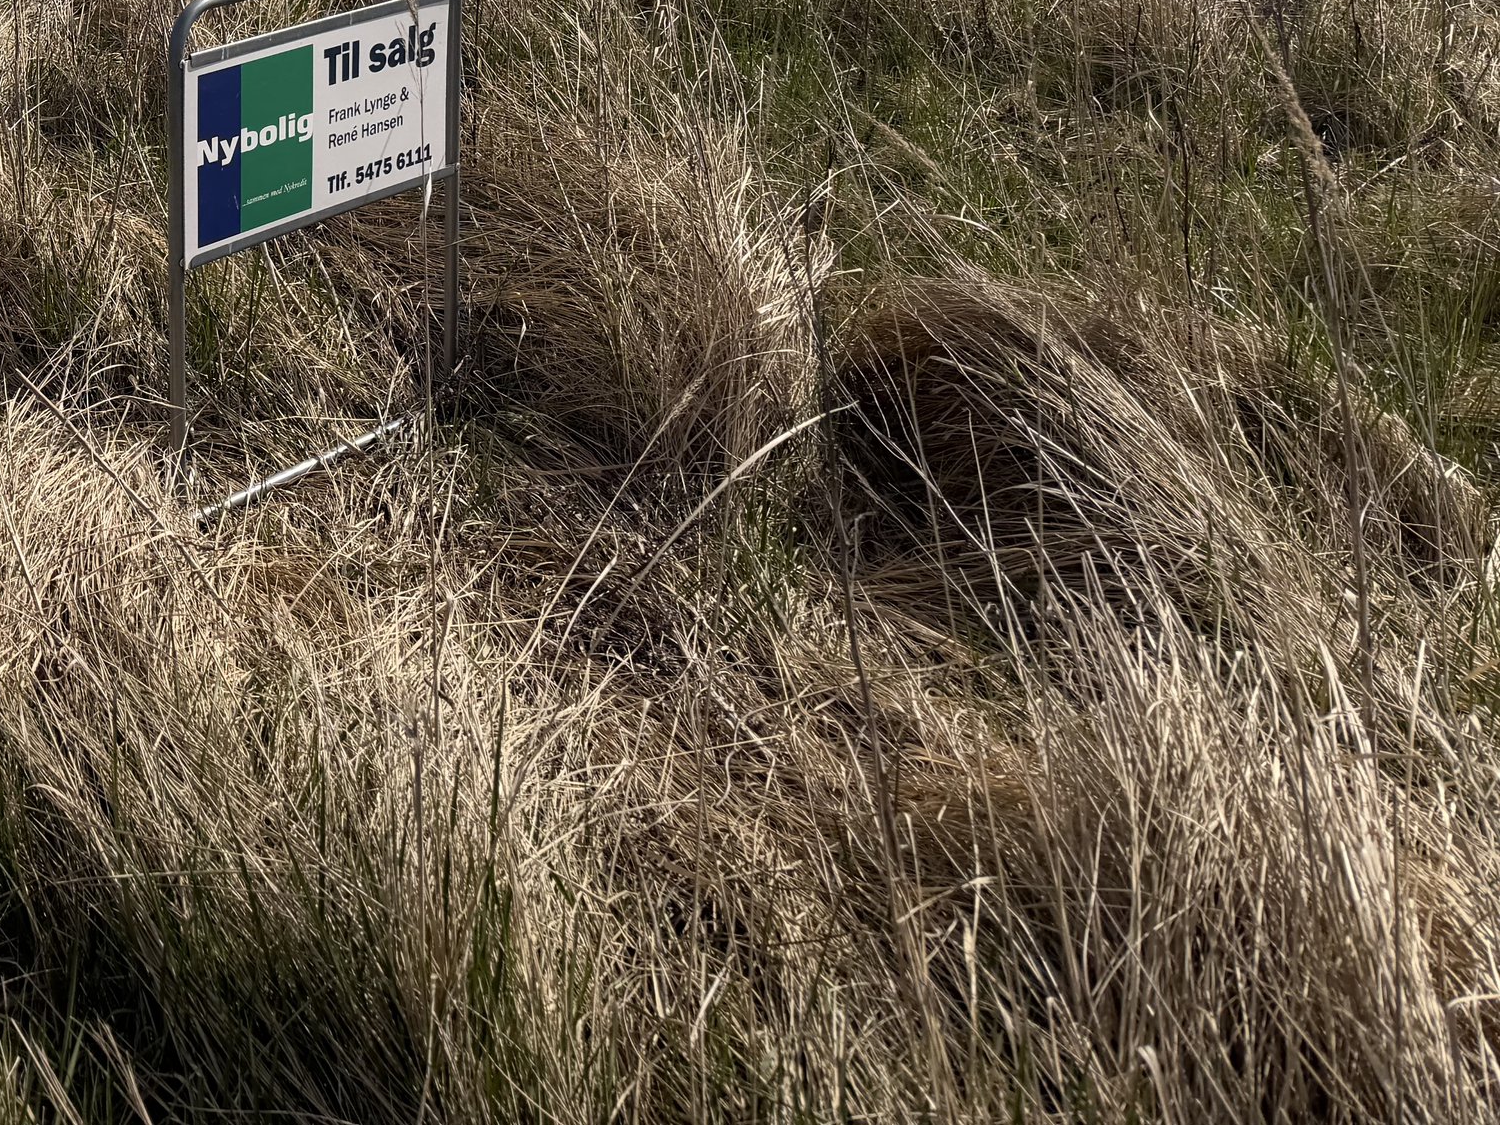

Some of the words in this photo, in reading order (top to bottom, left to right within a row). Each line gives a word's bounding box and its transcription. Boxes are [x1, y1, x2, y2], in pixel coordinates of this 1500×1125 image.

[324, 40, 359, 85] Til
[368, 22, 436, 72] salg
[328, 102, 361, 124] Frank
[364, 92, 396, 115] Lynge
[399, 87, 409, 101] &
[197, 113, 313, 166] Nybolig
[328, 126, 358, 149] René
[361, 114, 403, 138] Hansen
[327, 172, 351, 194] Tlf.
[356, 157, 392, 184] 5475
[396, 144, 432, 171] 6111
